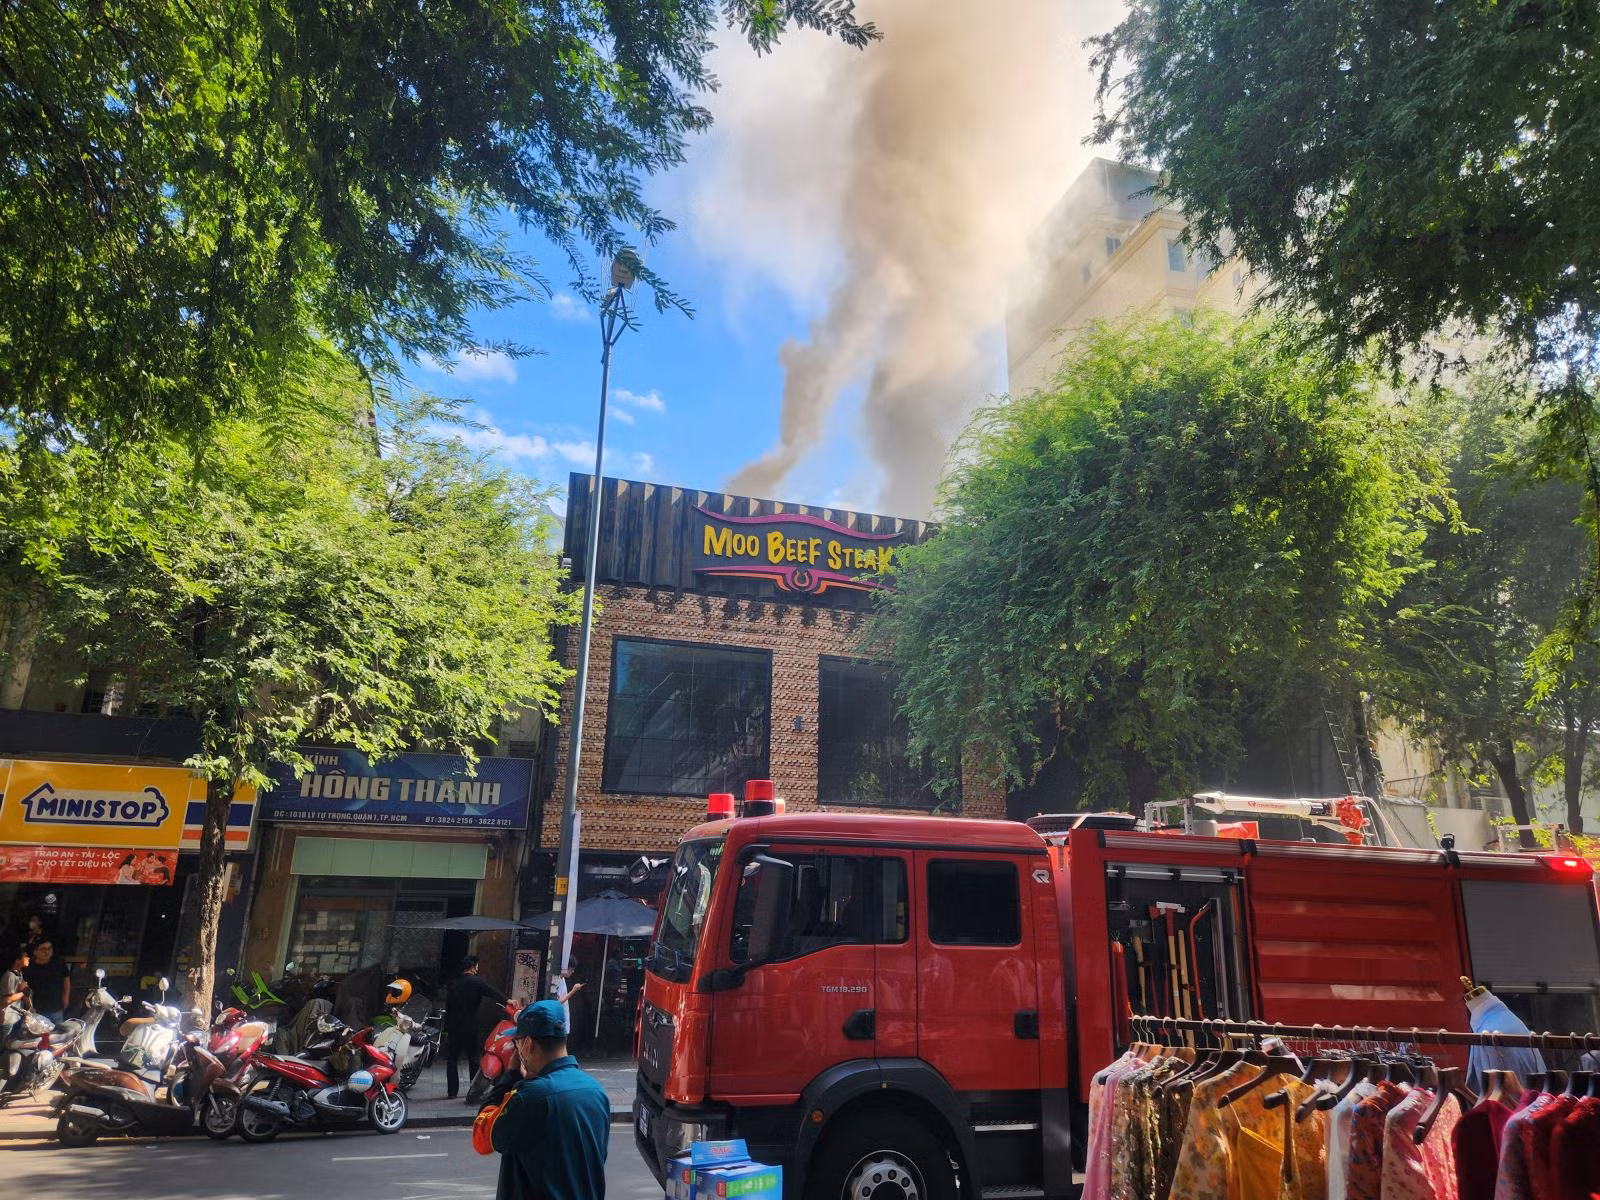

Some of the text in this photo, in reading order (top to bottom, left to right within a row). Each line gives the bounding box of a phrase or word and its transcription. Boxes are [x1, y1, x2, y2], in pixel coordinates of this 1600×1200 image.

[703, 524, 895, 575] MOO BEEF STEAK
[36, 797, 158, 820] MINISTOP
